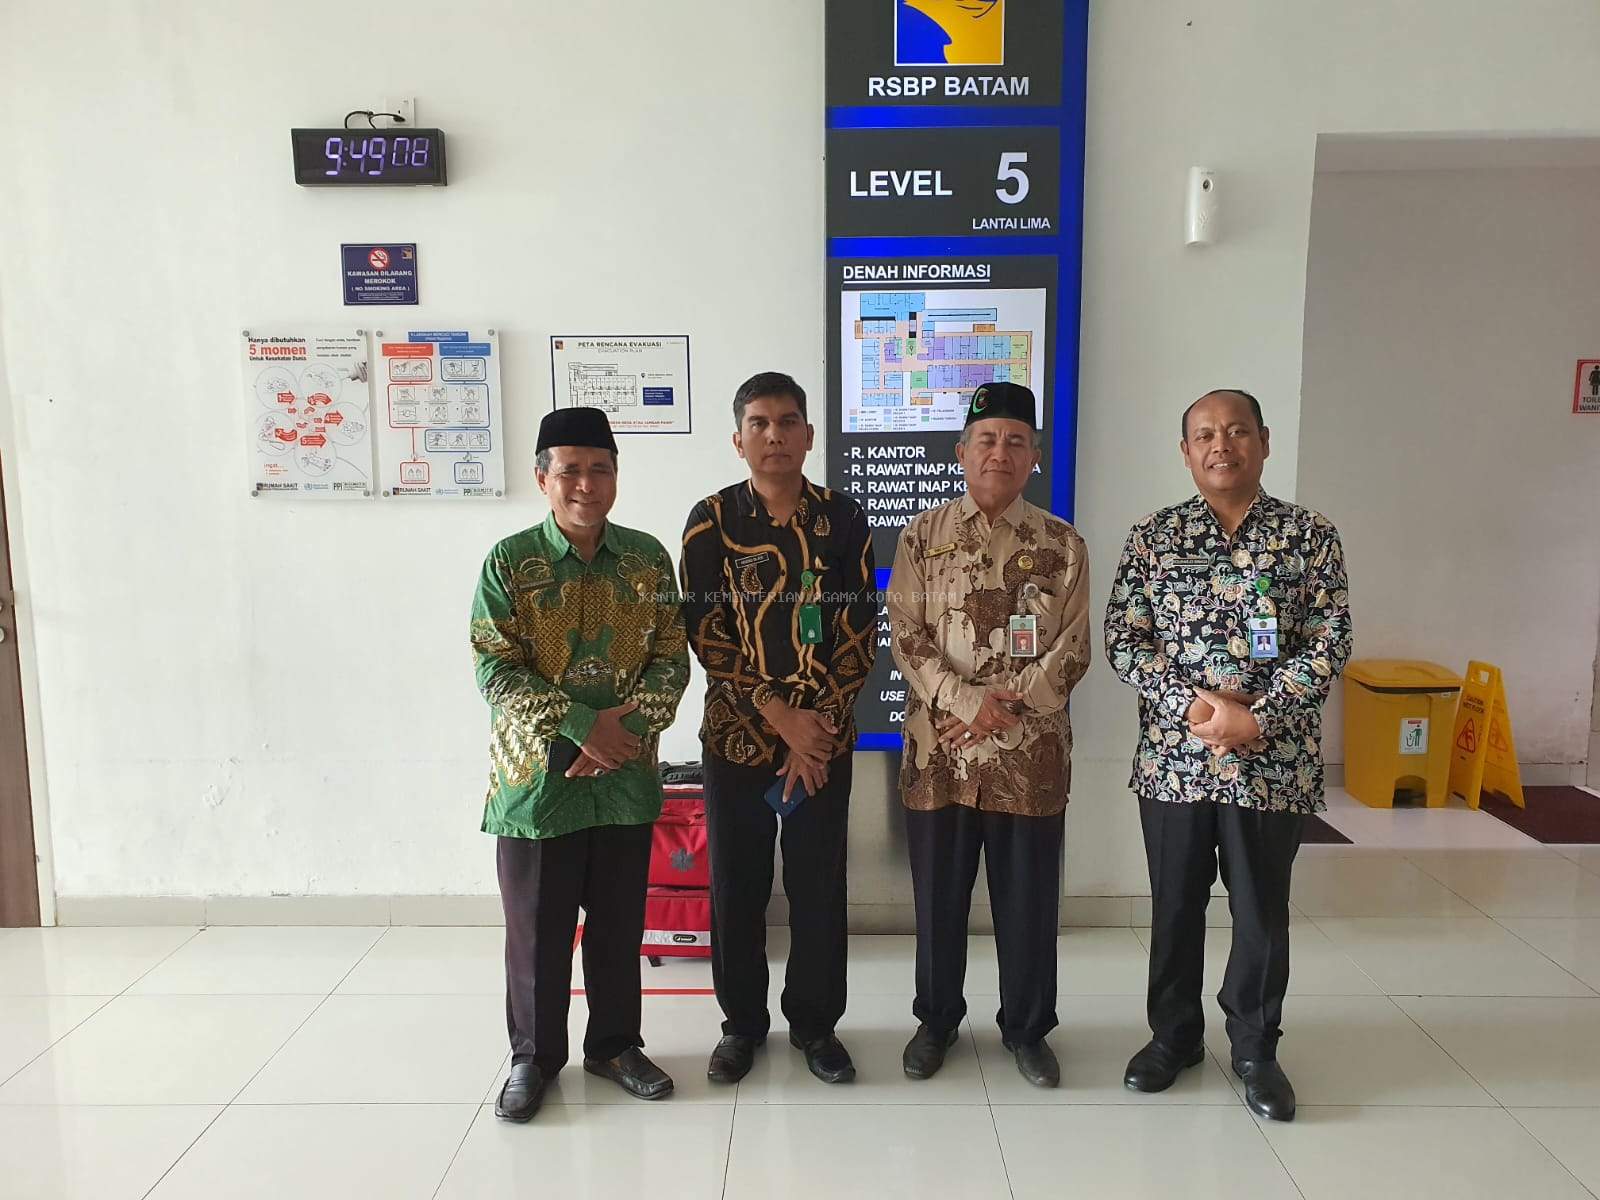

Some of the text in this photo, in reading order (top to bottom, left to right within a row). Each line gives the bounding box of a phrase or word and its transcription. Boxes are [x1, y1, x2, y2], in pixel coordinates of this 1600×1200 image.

[868, 76, 1029, 97] RSBP BATAM
[325, 137, 388, 176] 9:49
[849, 151, 1030, 205] LEVEL 5
[972, 217, 1051, 230] LANTAI LIMA
[843, 264, 991, 280] DENAH INFORMASI
[249, 344, 307, 355] 5 momen
[867, 446, 926, 459] KANTOR
[866, 463, 913, 476] RAWAT
[914, 463, 946, 475] INAP
[867, 481, 916, 493] RAWAT
[918, 481, 950, 492] INAP
[867, 498, 916, 510] RAWAT
[880, 690, 906, 701] USE
